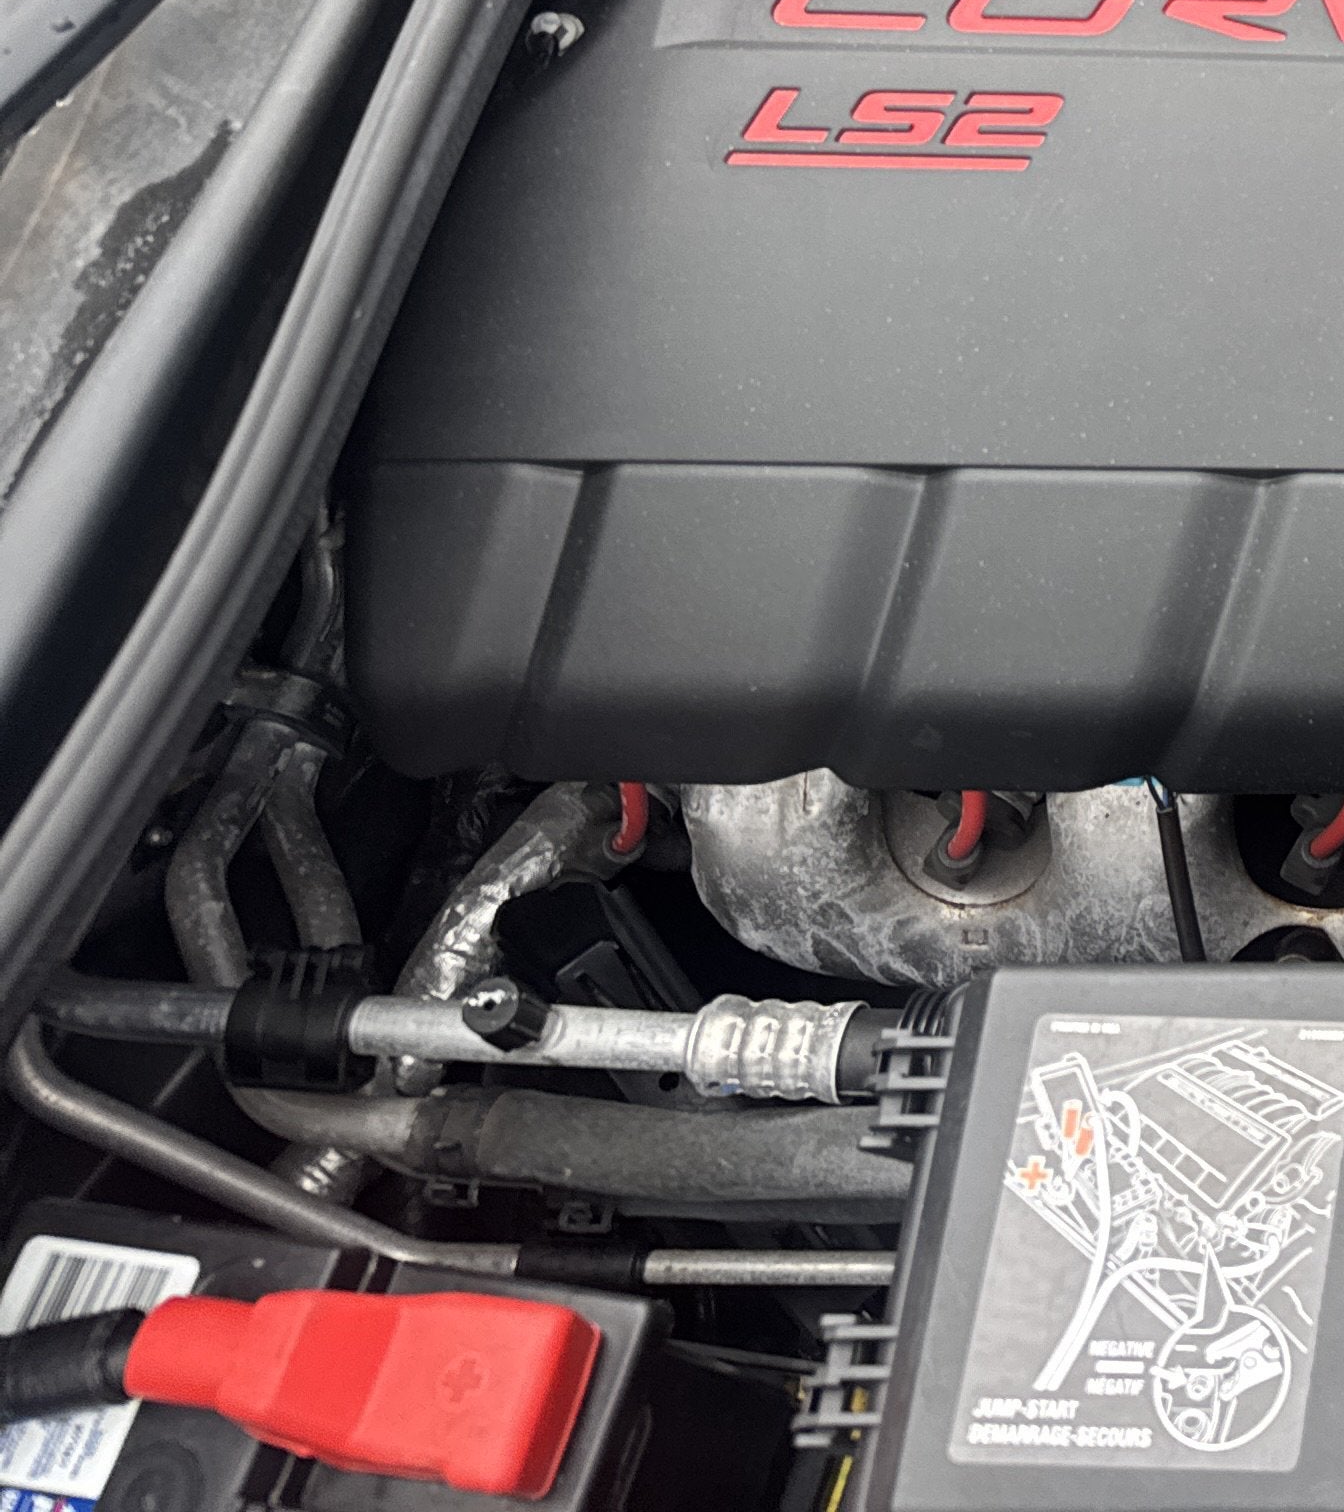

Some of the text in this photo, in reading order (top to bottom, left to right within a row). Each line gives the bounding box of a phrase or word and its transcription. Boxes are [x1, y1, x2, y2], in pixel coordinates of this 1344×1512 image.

[741, 86, 1065, 147] LS2
[1088, 1340, 1156, 1359] NEGATIVE
[971, 1397, 1080, 1420] JUMP-START
